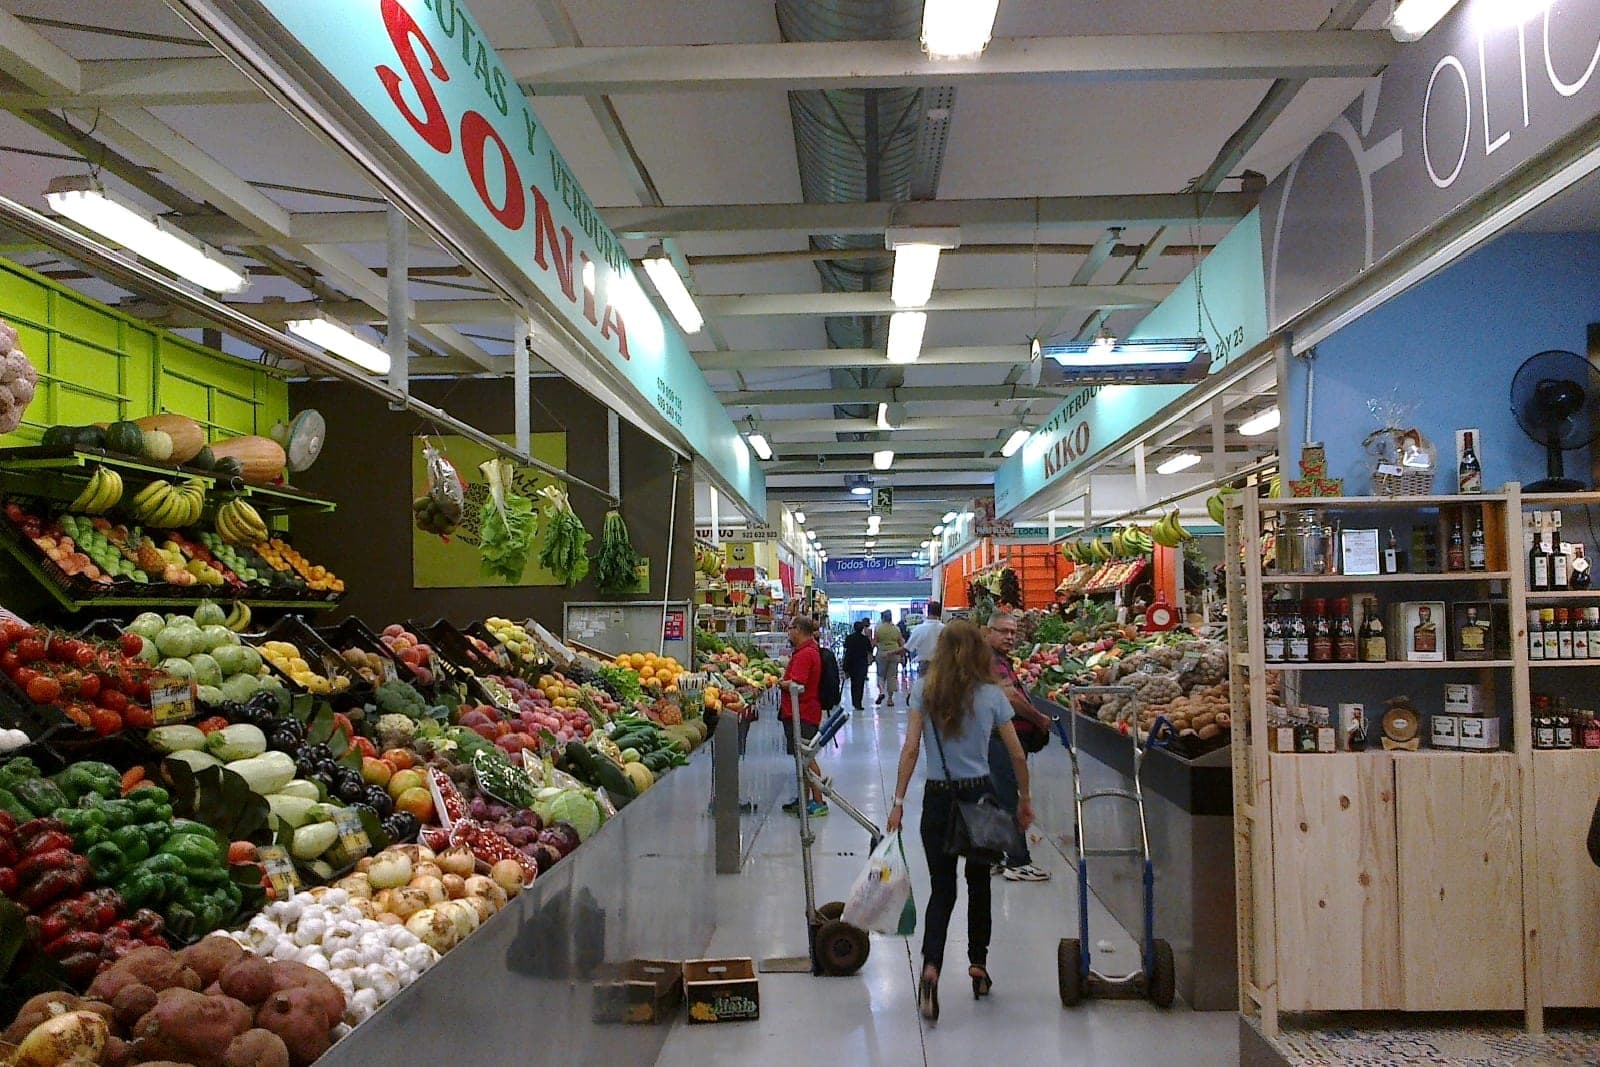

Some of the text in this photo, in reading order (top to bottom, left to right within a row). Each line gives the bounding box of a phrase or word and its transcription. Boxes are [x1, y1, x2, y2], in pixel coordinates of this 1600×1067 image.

[522, 107, 536, 156] Y
[374, 0, 631, 362] SONIA
[1225, 333, 1232, 353] Y
[1233, 325, 1244, 348] 23
[1062, 384, 1102, 424] VERDU
[1044, 420, 1090, 480] KIKO
[836, 560, 864, 570] Todos
